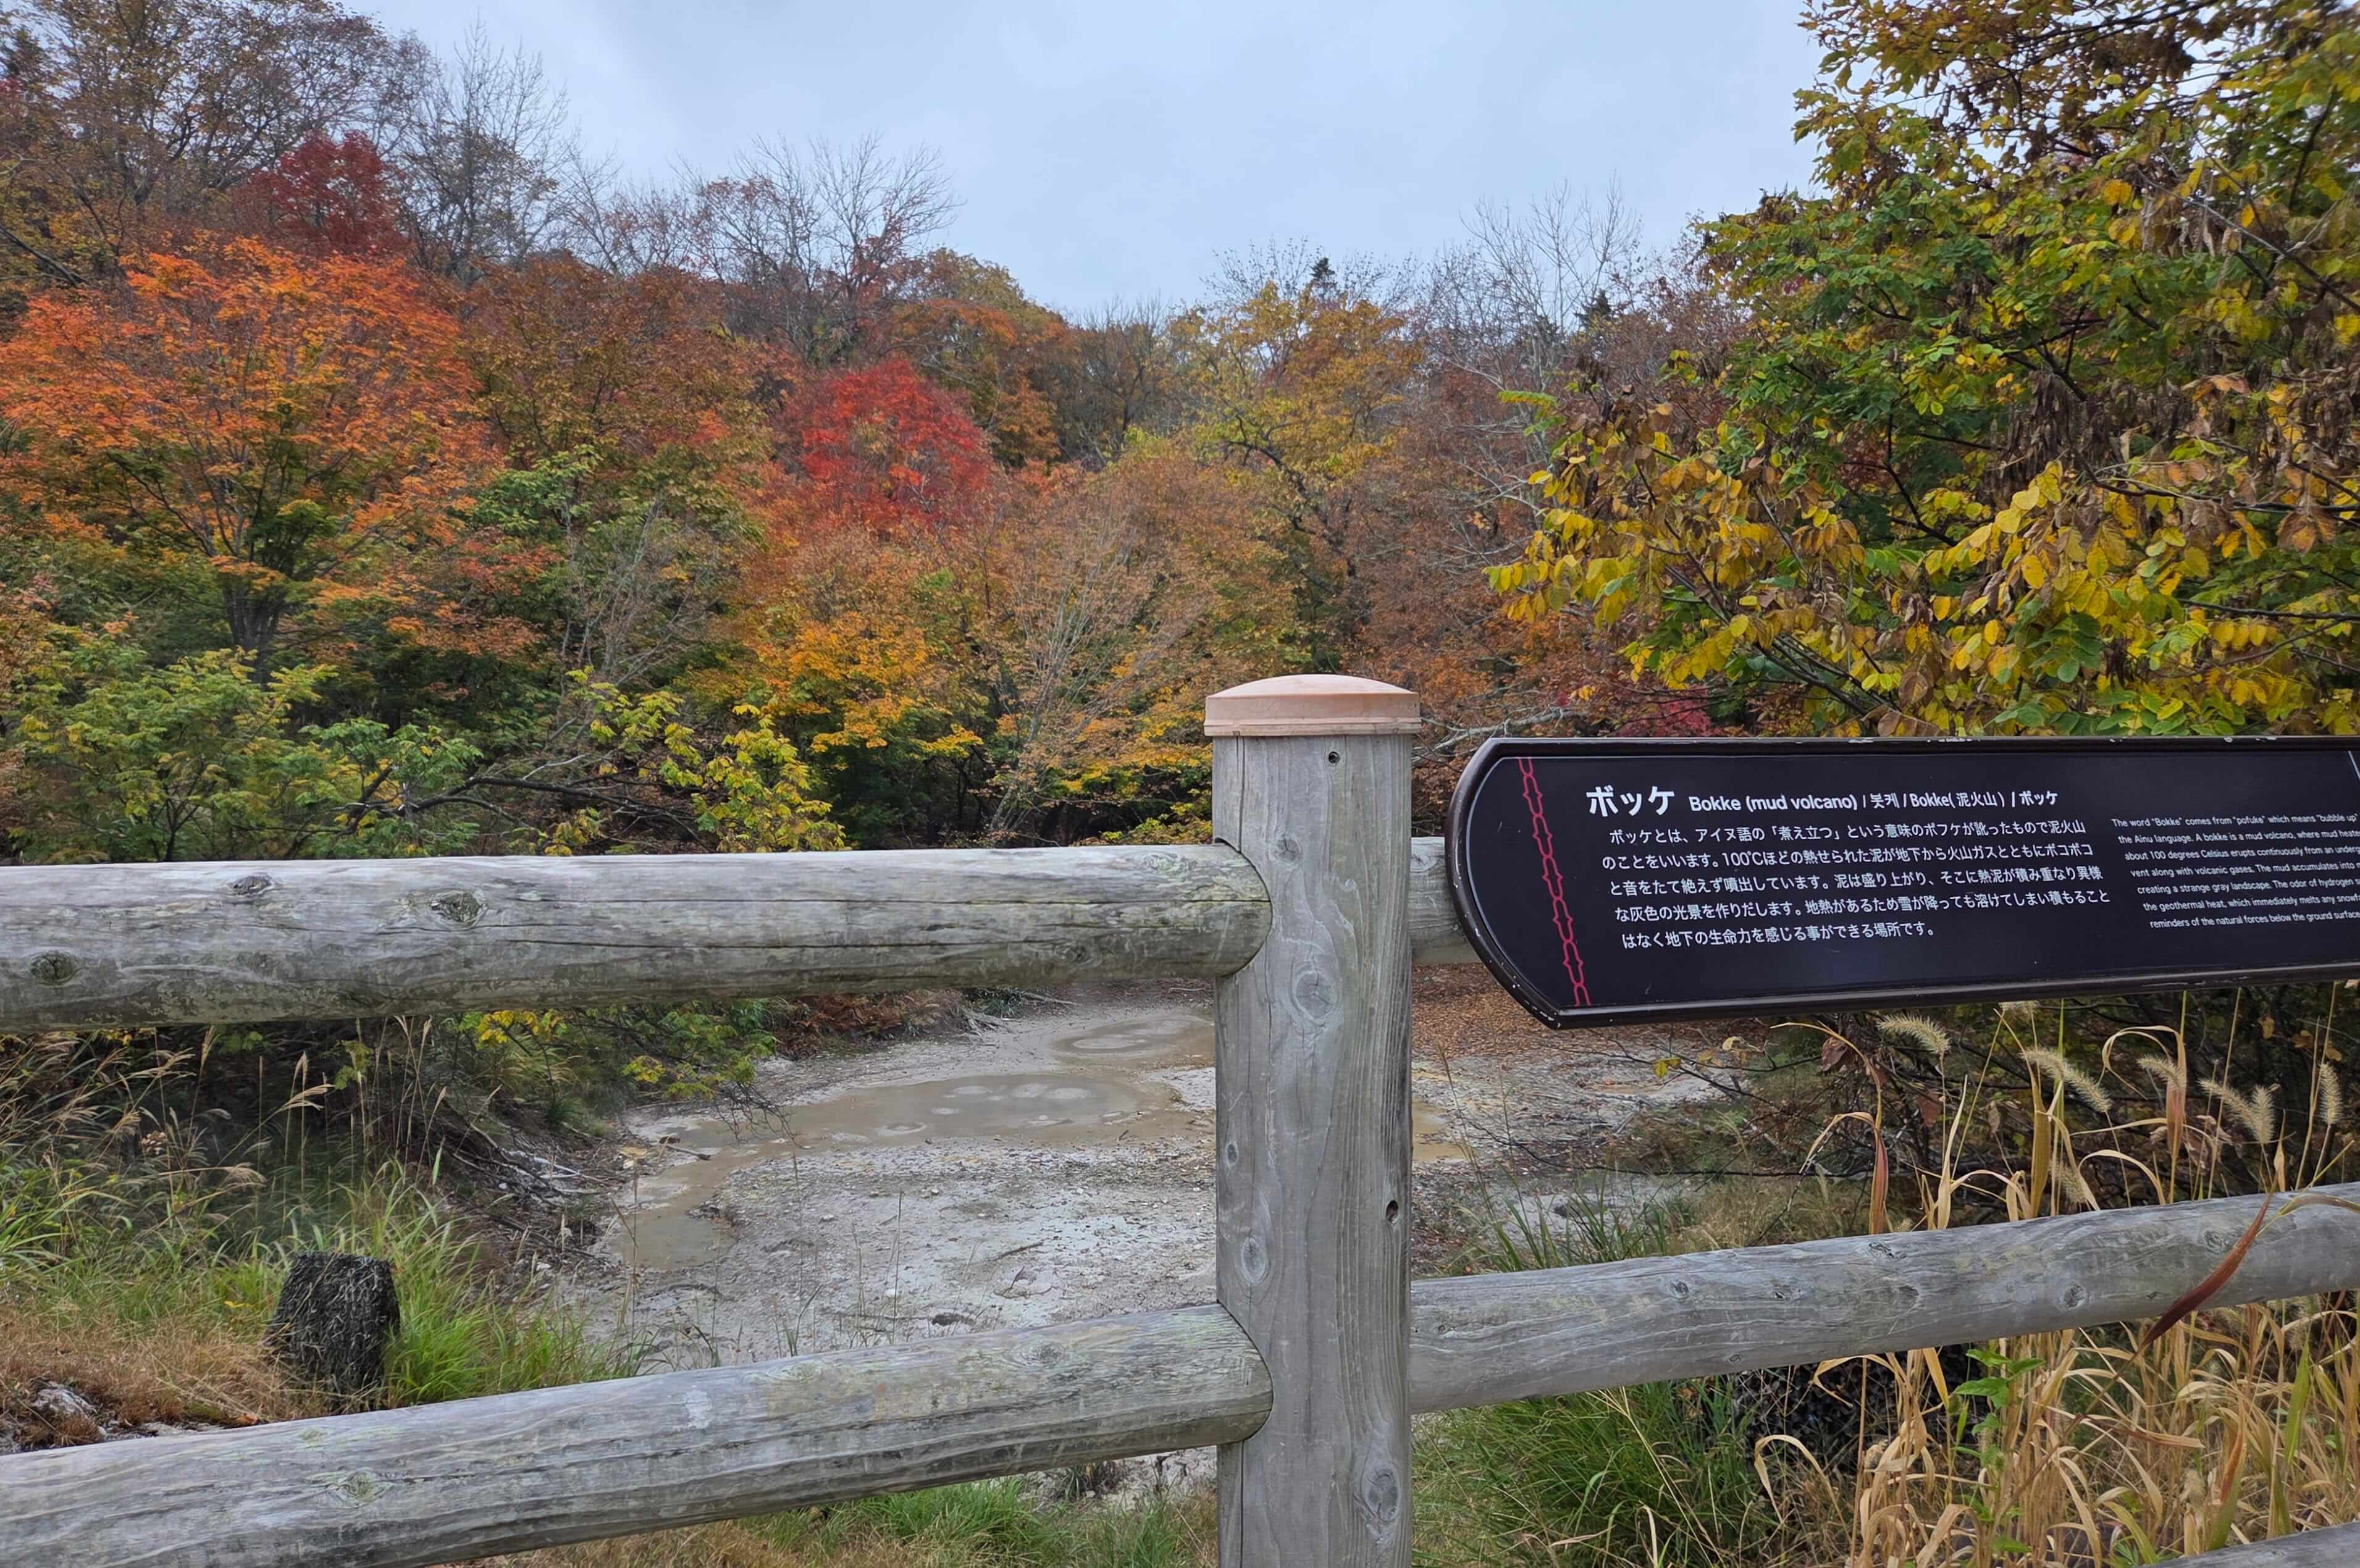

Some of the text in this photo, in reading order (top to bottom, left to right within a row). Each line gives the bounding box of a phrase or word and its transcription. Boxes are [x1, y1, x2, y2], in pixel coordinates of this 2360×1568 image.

[1585, 784, 1675, 817] ボッケ
[1688, 795, 1742, 811] Bokke
[1746, 795, 1789, 813] (mud
[1790, 794, 1858, 811] volcano)
[2112, 819, 2128, 827] The
[2130, 818, 2151, 826] word
[2268, 815, 2290, 823] which
[2135, 835, 2152, 843] Ainu
[2154, 835, 2194, 844] language.
[2150, 851, 2166, 859] 100
[2168, 851, 2199, 860] degrees
[2230, 850, 2256, 858] erupts
[2257, 847, 2303, 856] continuously
[2151, 868, 2175, 878] along
[2194, 866, 2228, 874] volcanic
[2229, 866, 2254, 875] gases.
[2272, 863, 2290, 871] mud
[2291, 862, 2339, 871] accumulates
[2339, 862, 2355, 870] into
[2137, 885, 2171, 894] creating
[2180, 884, 2211, 893] strange
[2212, 884, 2229, 892] gray
[2231, 882, 2272, 891] landscape.
[2272, 880, 2288, 888] The
[2290, 879, 2307, 887] odor
[2309, 879, 2317, 887] of
[2318, 878, 2354, 888] hydrogen
[2143, 903, 2157, 911] the
[2159, 900, 2204, 912] geothermal
[2228, 899, 2250, 907] which
[2253, 897, 2298, 906] immediately
[2299, 895, 2320, 903] melts
[2322, 895, 2335, 904] any
[2150, 919, 2190, 928] reminders
[2191, 918, 2199, 926] of
[2201, 917, 2214, 925] the
[2216, 915, 2243, 924] natural
[2244, 915, 2269, 923] forces
[2269, 914, 2291, 922] below
[2306, 912, 2332, 922] ground
